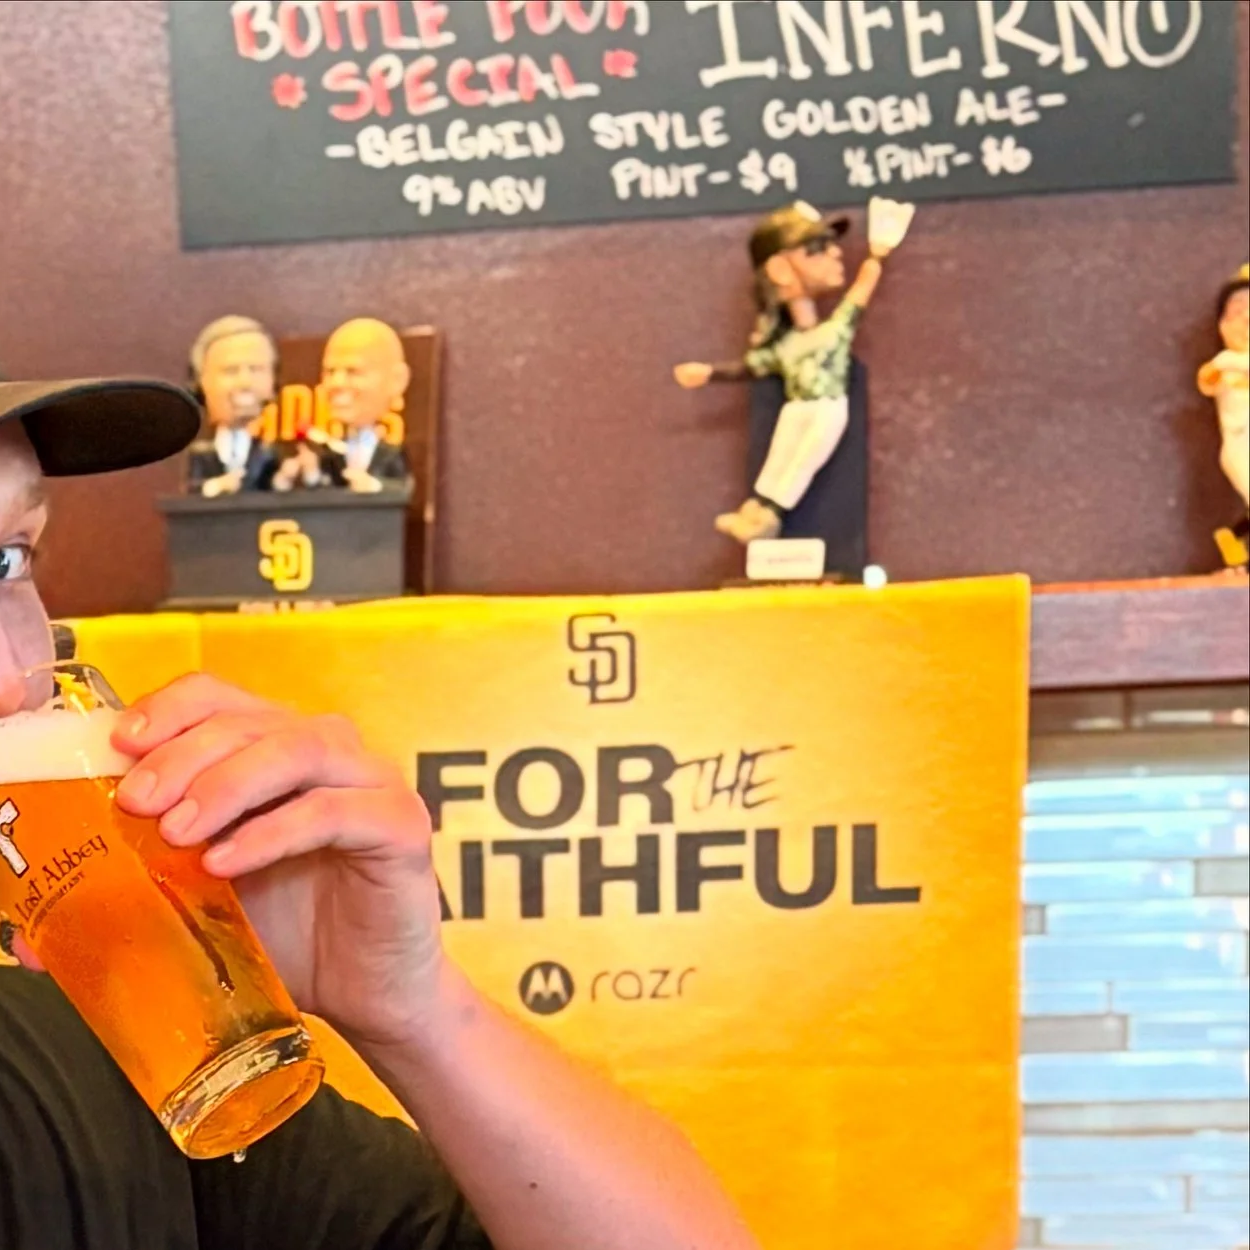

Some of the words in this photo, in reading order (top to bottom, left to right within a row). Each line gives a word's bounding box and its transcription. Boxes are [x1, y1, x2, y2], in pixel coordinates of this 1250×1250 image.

[230, 1, 457, 61] BOTTLE
[685, 1, 1202, 88] INFERNO
[321, 53, 601, 121] SPECIAL
[588, 106, 730, 153] STYLE
[762, 92, 932, 140] GOLDEN
[258, 519, 314, 592] SD
[567, 612, 638, 705] SD
[416, 743, 676, 834] FOR
[672, 744, 796, 813] THE
[42, 833, 109, 891] Abbey
[438, 822, 923, 922] ITHFUL
[590, 966, 698, 1003] razr
